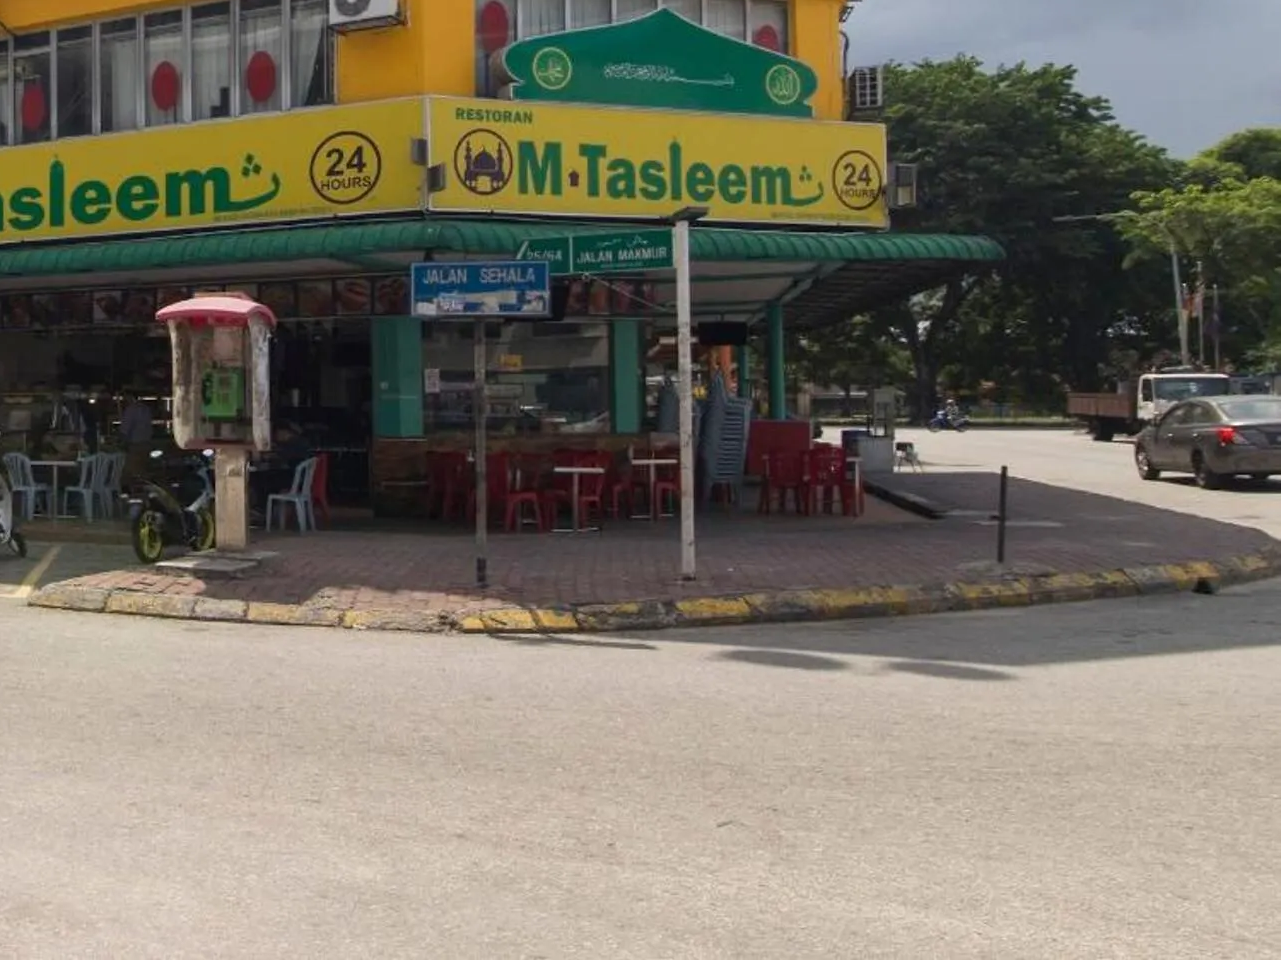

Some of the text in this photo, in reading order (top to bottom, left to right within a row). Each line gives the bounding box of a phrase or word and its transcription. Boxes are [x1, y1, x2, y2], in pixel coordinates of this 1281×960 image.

[455, 107, 533, 125] RESTORAN
[326, 145, 367, 177] 24
[320, 173, 372, 192] HOURS
[842, 162, 871, 187] 24
[840, 186, 877, 200] HOURS
[577, 247, 667, 264] JALAN MAKMUR
[423, 268, 536, 284] JALAN SEHALA
